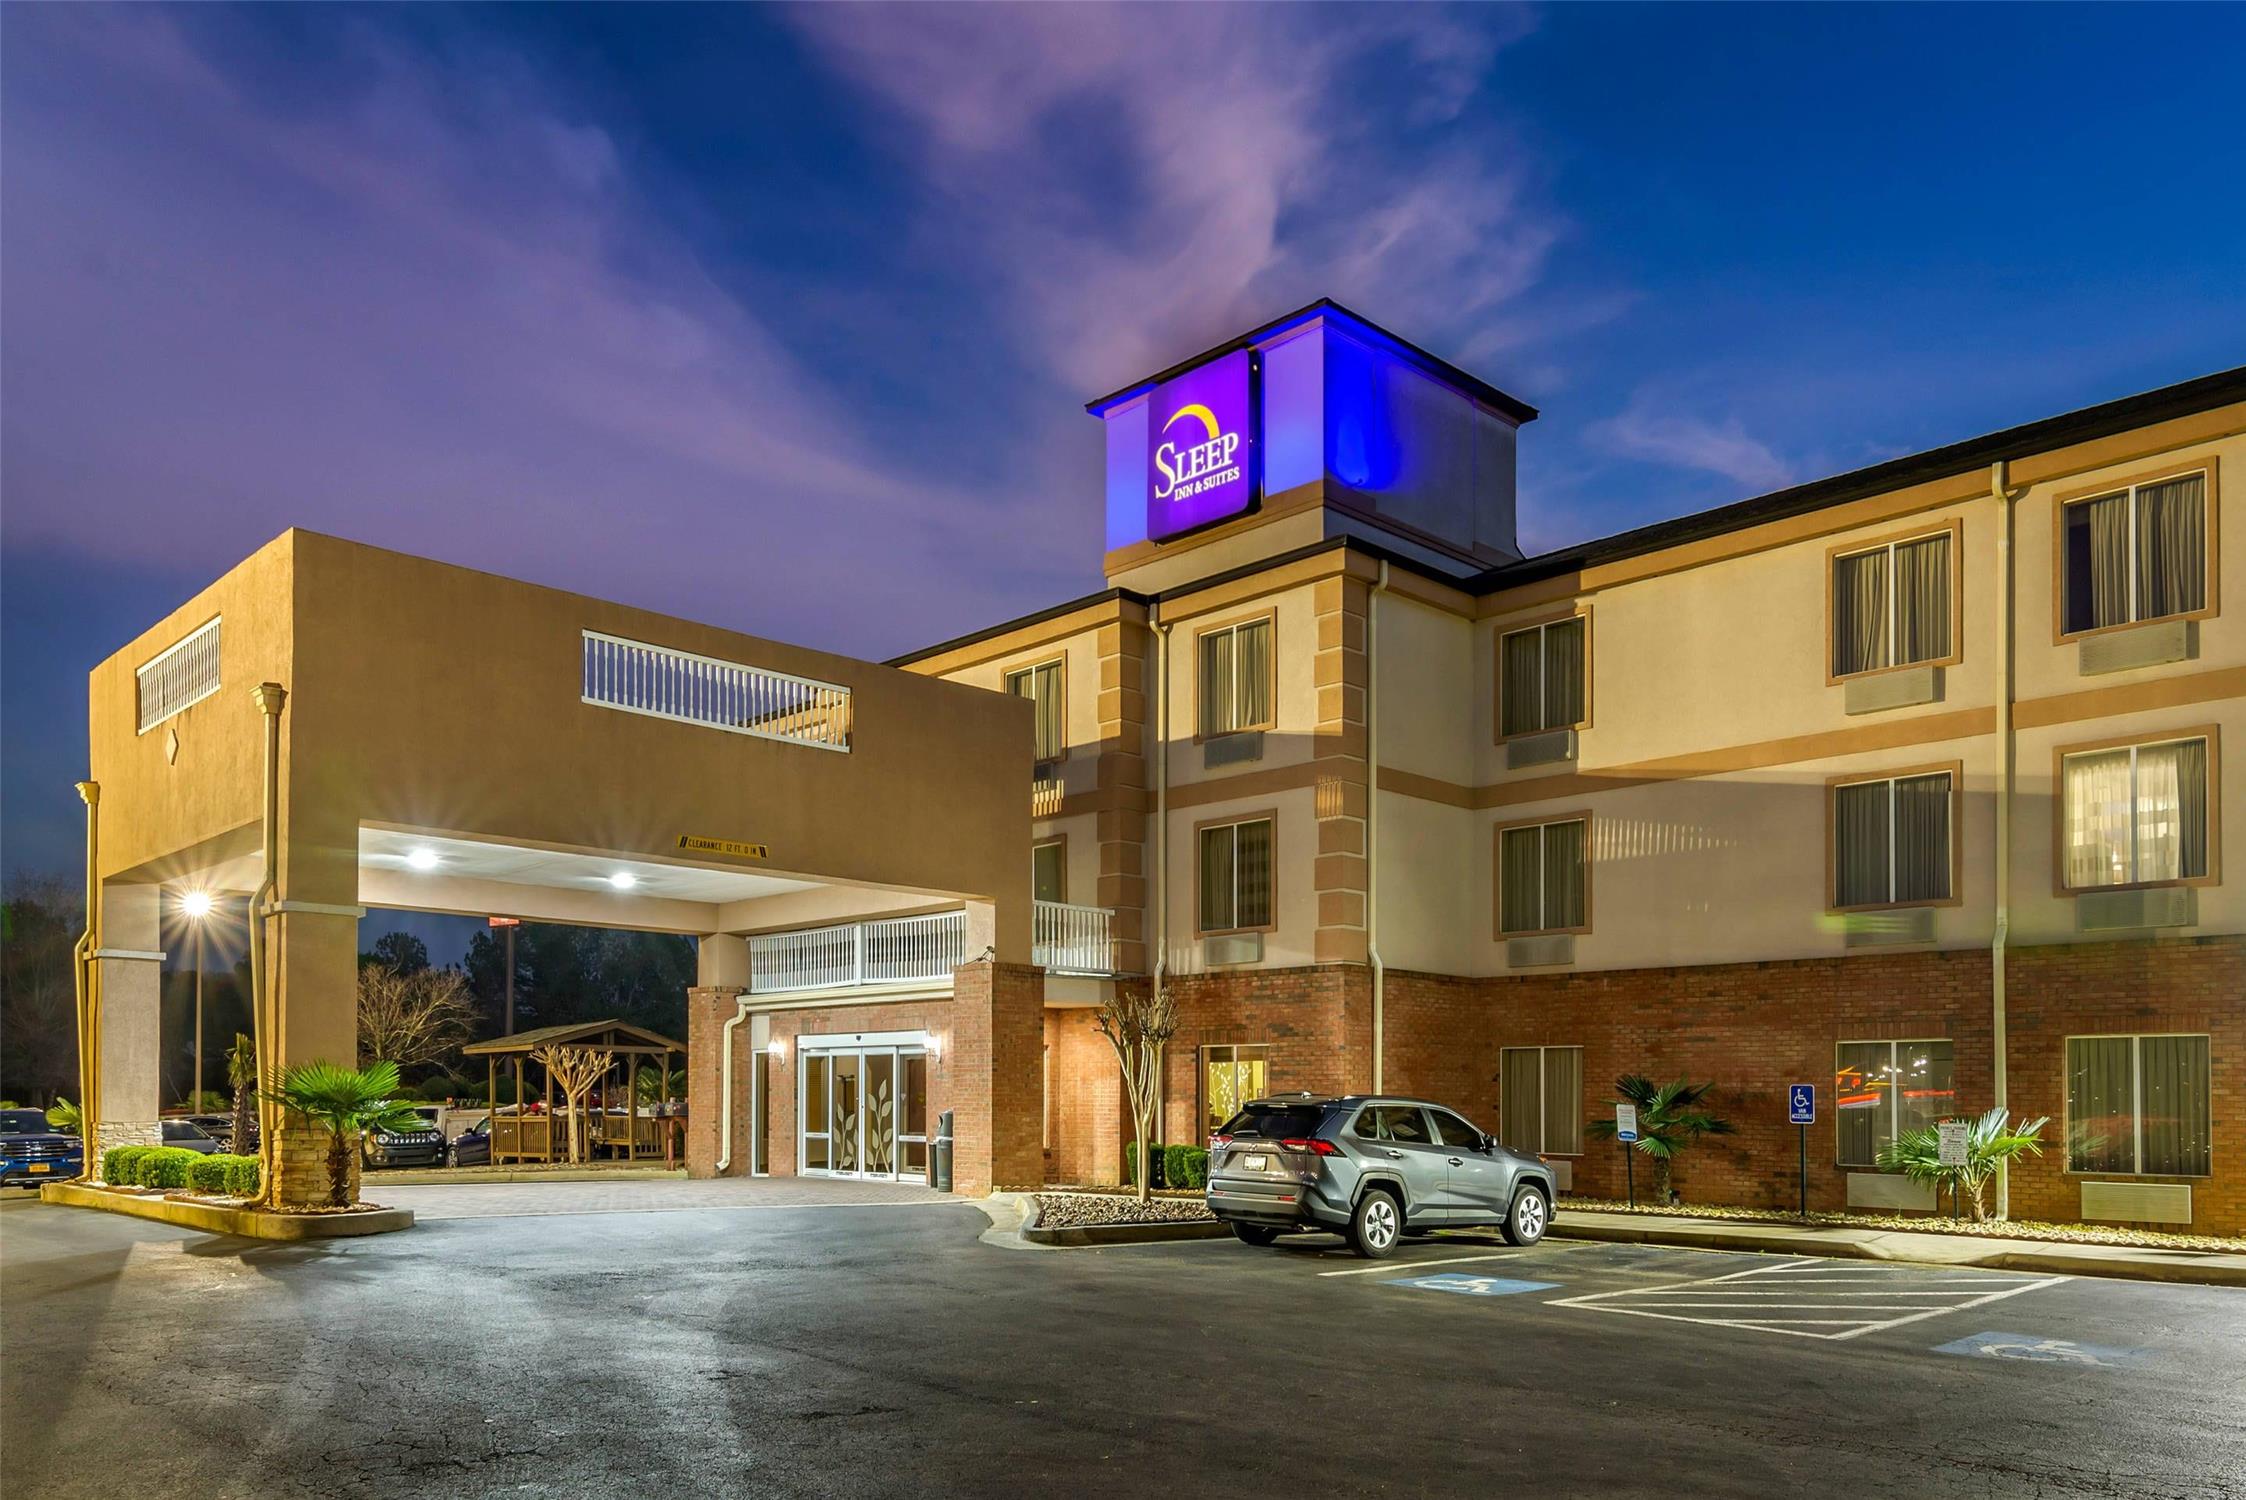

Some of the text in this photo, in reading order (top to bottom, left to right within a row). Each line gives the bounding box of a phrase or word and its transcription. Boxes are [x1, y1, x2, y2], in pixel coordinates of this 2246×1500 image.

[1155, 432, 1239, 499] SLEEP
[1174, 467, 1240, 501] INN & SUITES
[688, 839, 722, 851] CLEARANCE
[726, 843, 732, 852] 12
